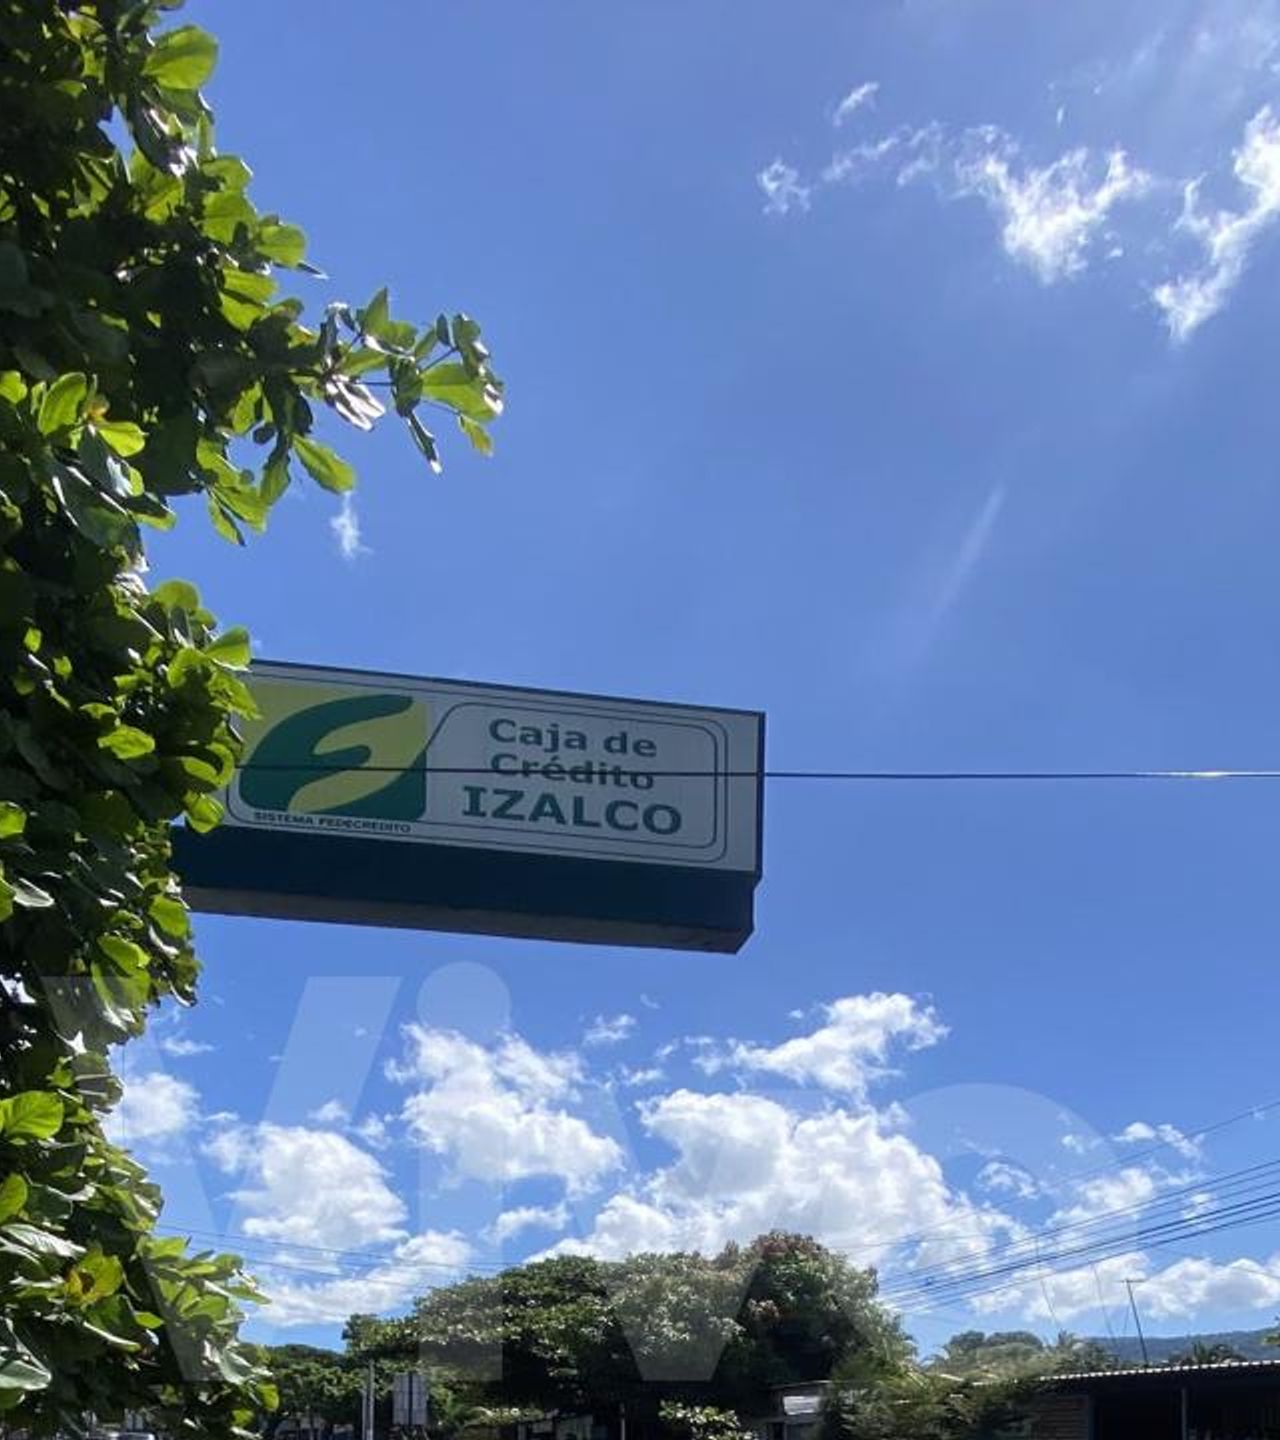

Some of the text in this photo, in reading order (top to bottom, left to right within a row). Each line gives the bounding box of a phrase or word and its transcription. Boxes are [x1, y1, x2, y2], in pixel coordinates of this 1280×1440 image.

[488, 718, 658, 758] Caja de
[490, 753, 655, 790] Crédito
[253, 811, 314, 826] SISTEMA
[461, 785, 682, 836] IZALCO
